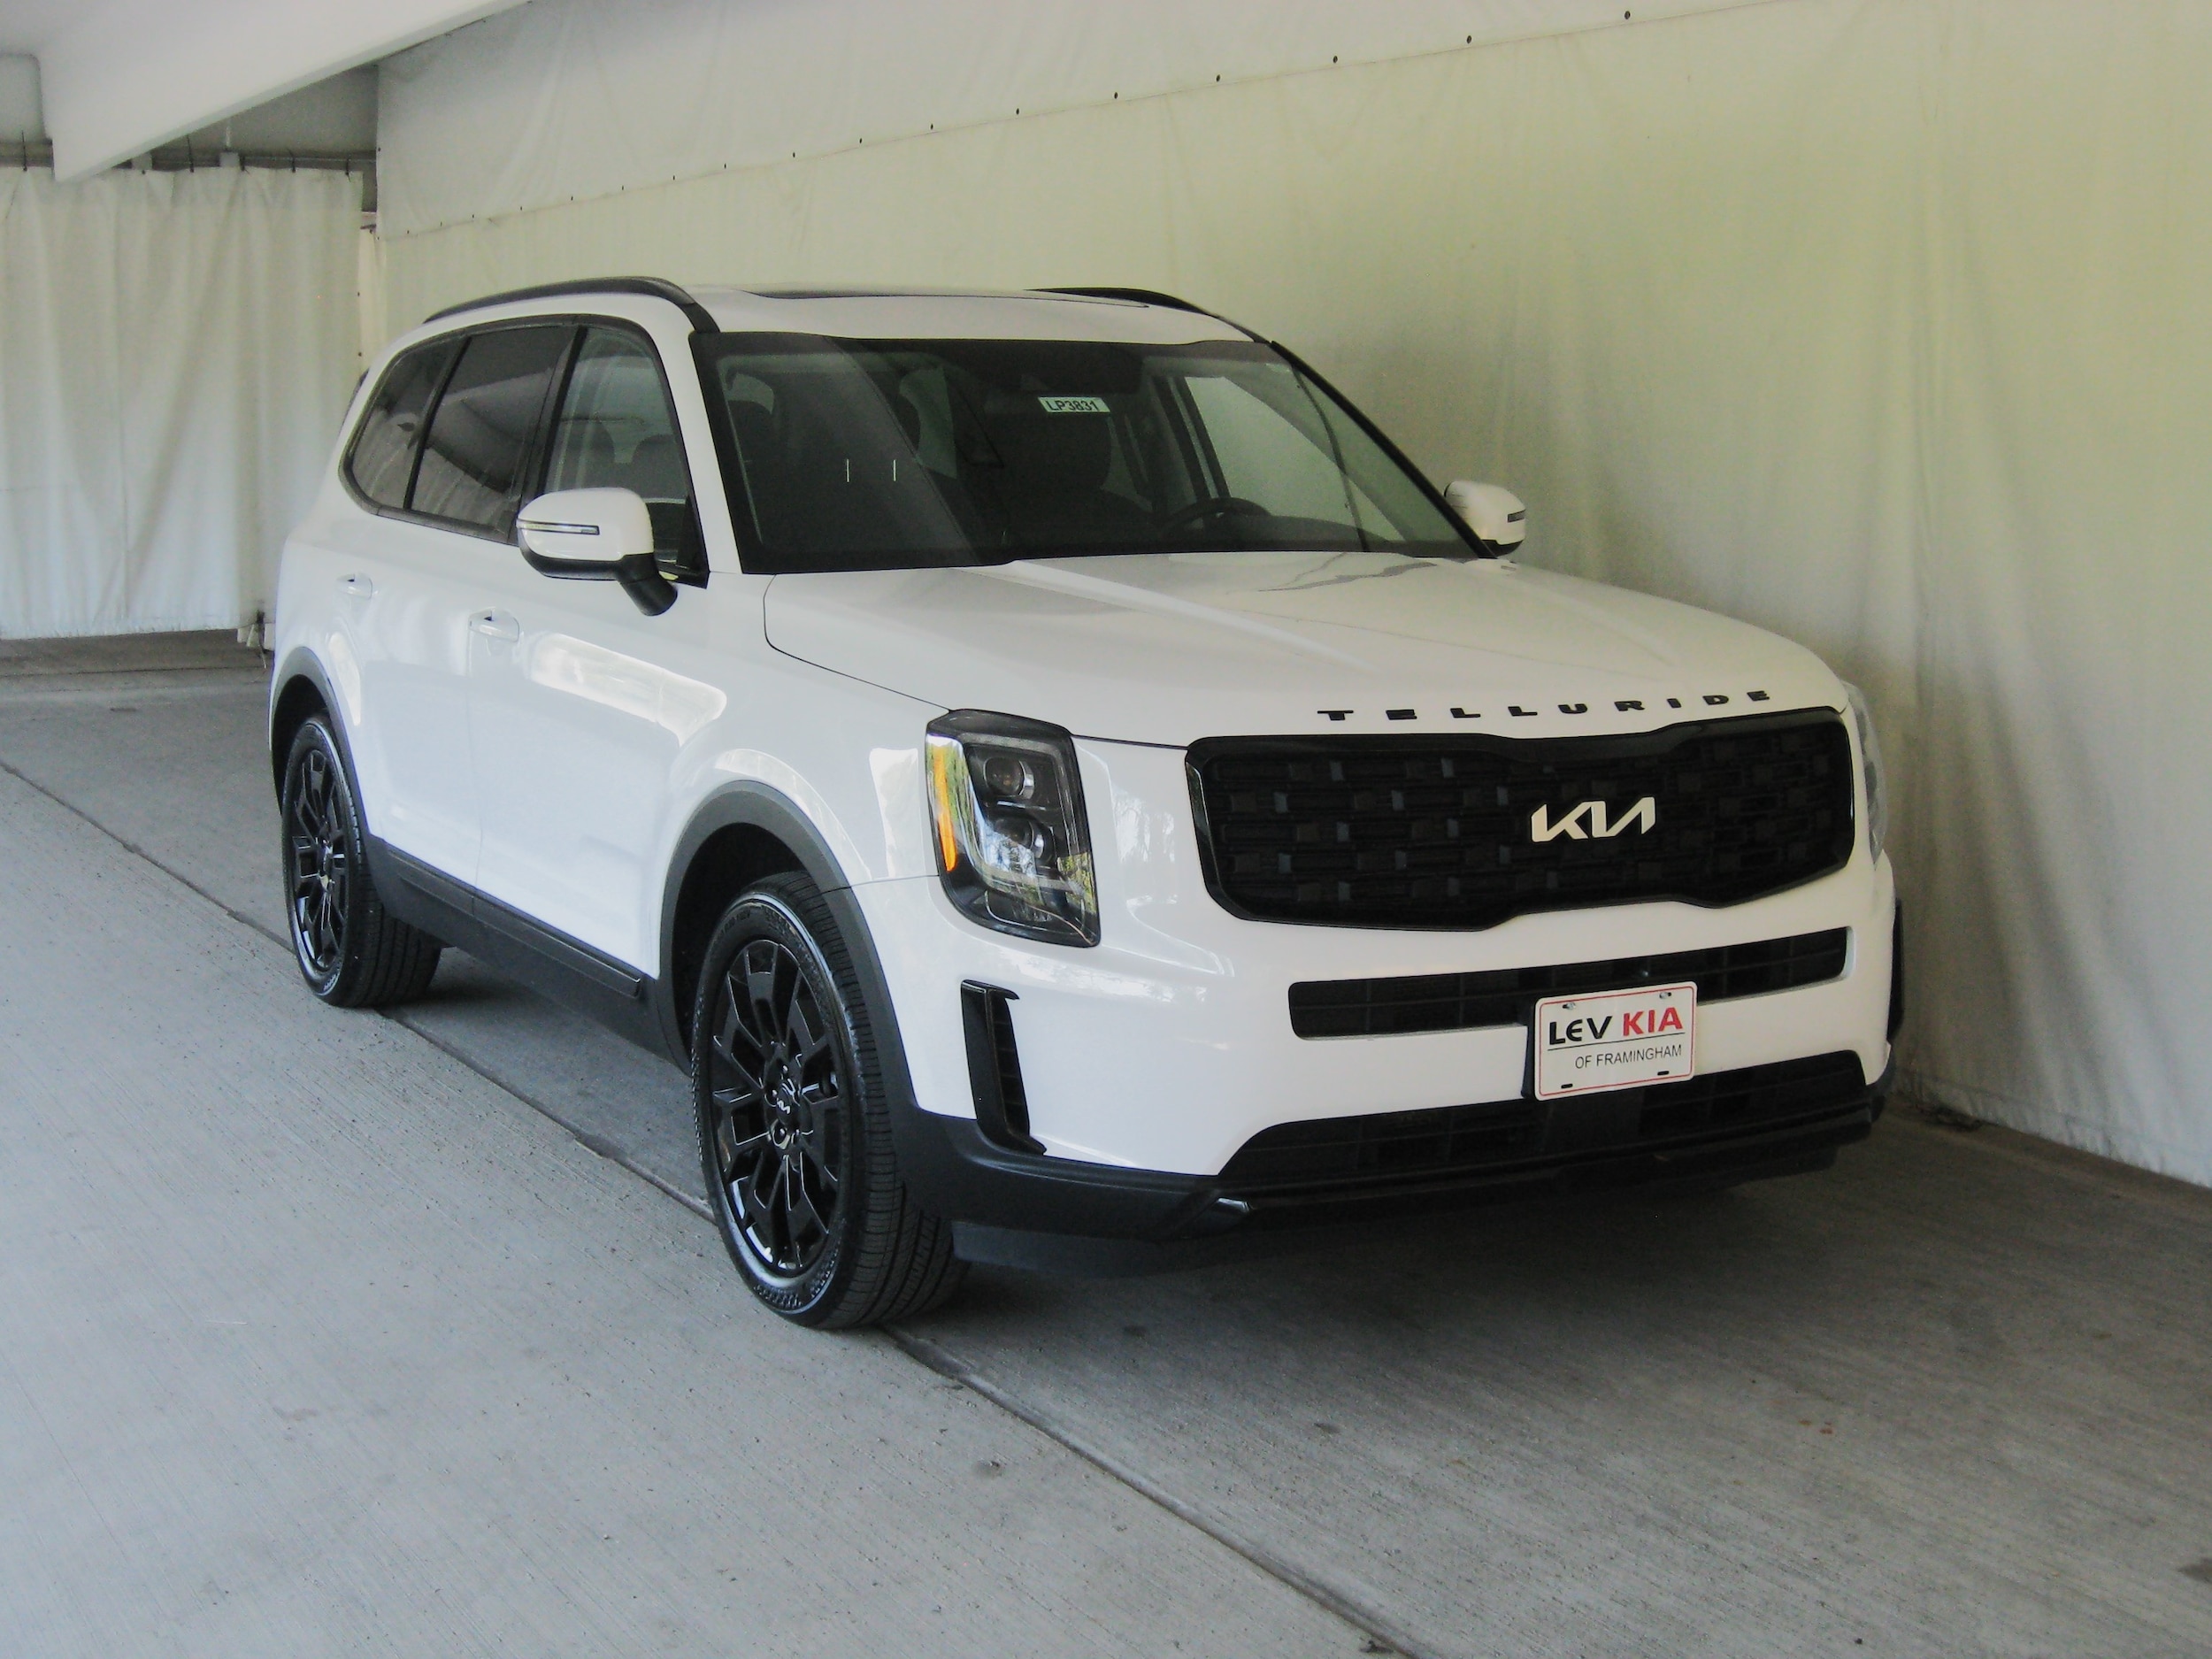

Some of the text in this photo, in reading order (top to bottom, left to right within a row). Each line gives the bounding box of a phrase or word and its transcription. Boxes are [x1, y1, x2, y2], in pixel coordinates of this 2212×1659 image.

[1045, 400, 1100, 411] LP3831
[1317, 690, 1770, 721] TELLURIDE
[1531, 796, 1655, 842] KIA
[1549, 1007, 1683, 1045] LEV KIA
[1575, 1044, 1682, 1069] OF FRAMINGHAM
